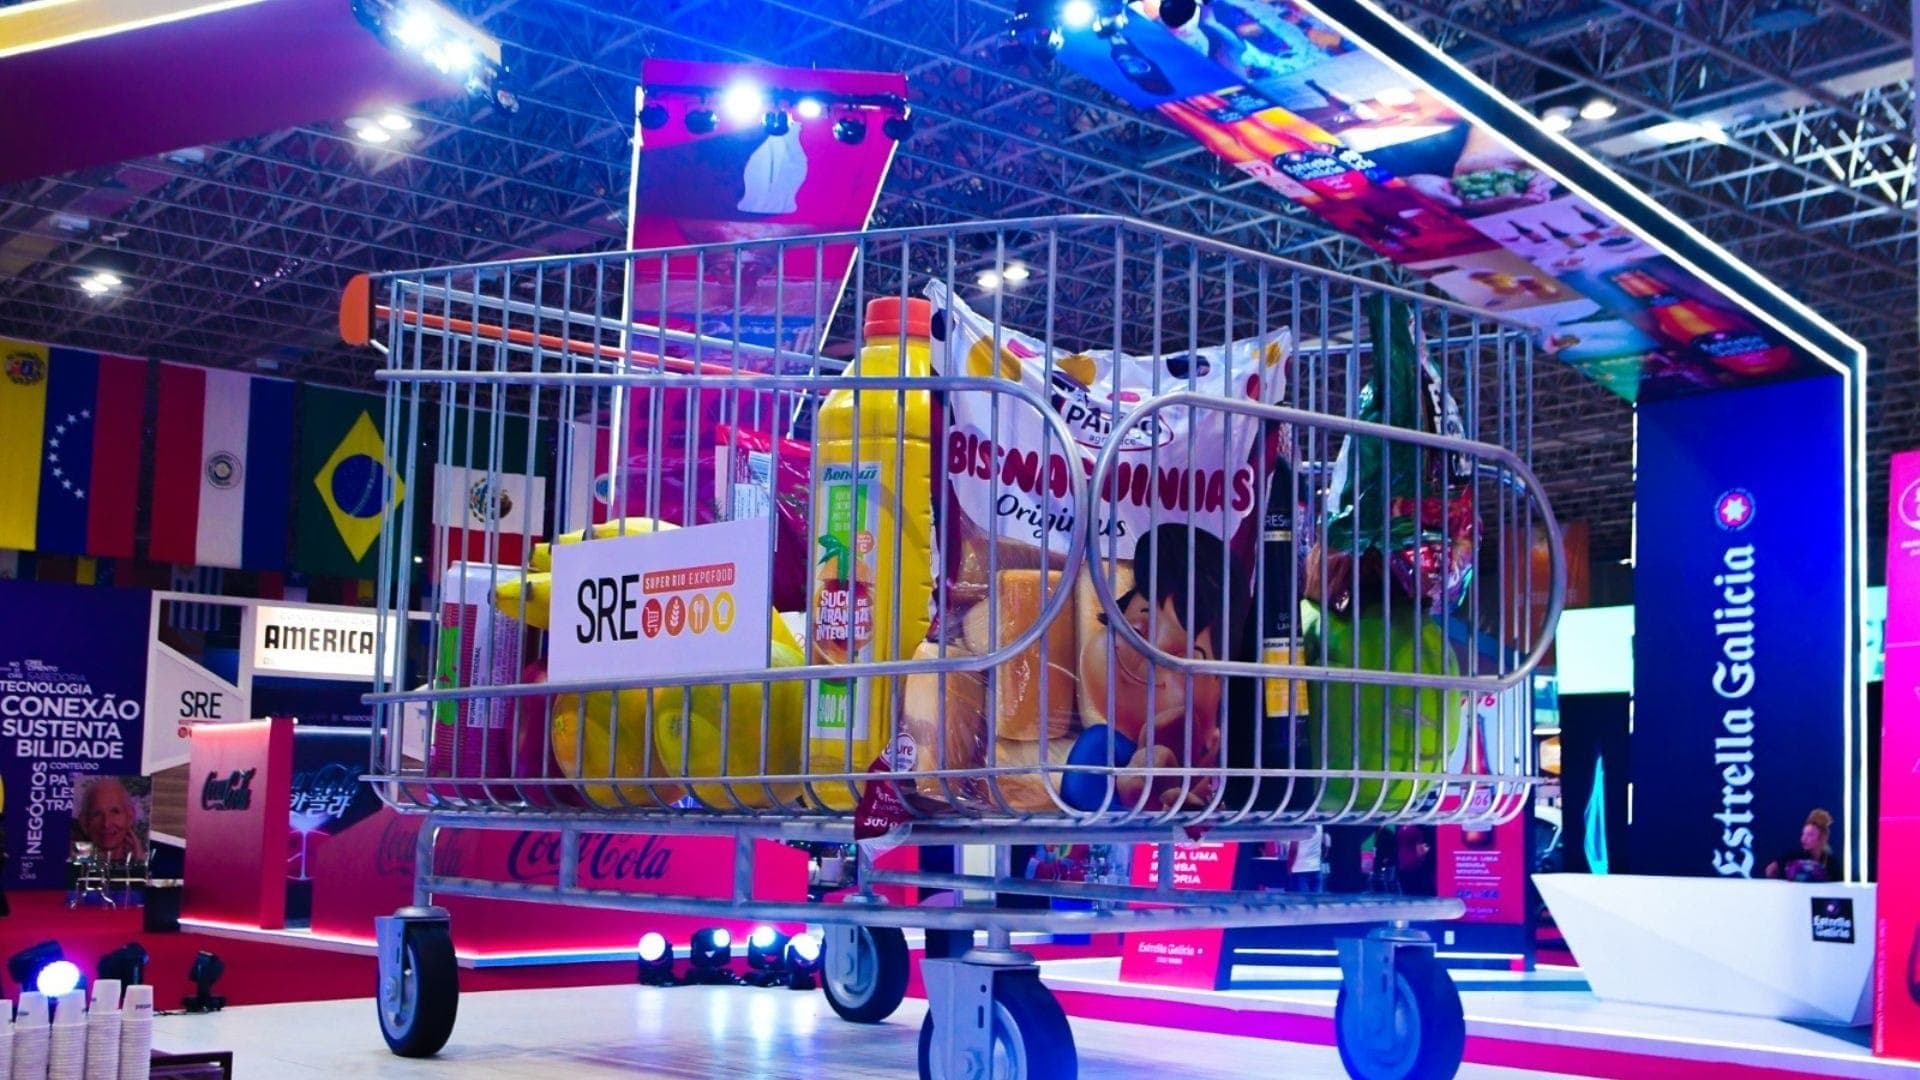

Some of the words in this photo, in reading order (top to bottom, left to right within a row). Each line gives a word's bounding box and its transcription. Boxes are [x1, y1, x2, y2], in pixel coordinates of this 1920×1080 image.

[948, 430, 1251, 514] BISNAUINHAS
[644, 577, 671, 591] SUPER
[671, 573, 687, 587] RIO
[576, 573, 641, 645] SRE
[1711, 543, 1756, 699] Galicia
[264, 624, 375, 655] AMERICA
[0, 680, 92, 695] TECNOLOGIA
[1, 693, 141, 721] CONEXÃO
[180, 690, 224, 720] SRE
[2, 718, 122, 740] SUSTENTA
[16, 739, 124, 759] BILIDADE
[49, 761, 100, 771] CONTEÚDO
[49, 774, 68, 786] PA
[1711, 706, 1756, 879] Estrella
[26, 761, 48, 855] NEGÓCIOS
[1189, 850, 1219, 862] UMA
